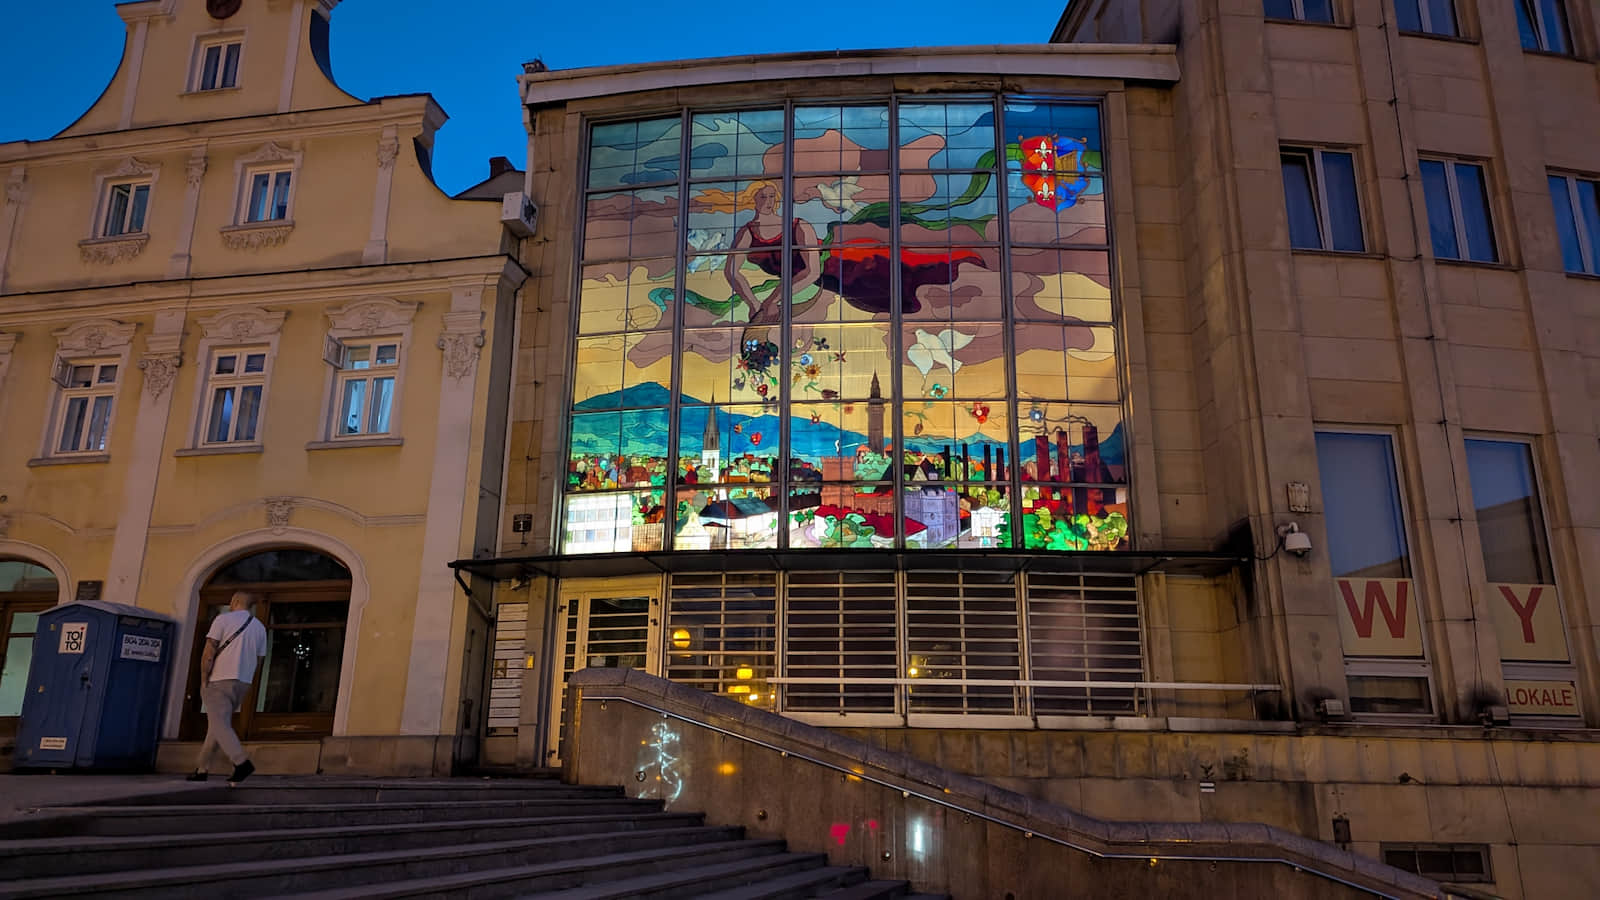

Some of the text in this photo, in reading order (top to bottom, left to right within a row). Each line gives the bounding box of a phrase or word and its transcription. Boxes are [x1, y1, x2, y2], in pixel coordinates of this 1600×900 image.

[1337, 579, 1544, 644] W Y
[65, 641, 82, 651] TOI
[1505, 687, 1575, 707] LOKALE
